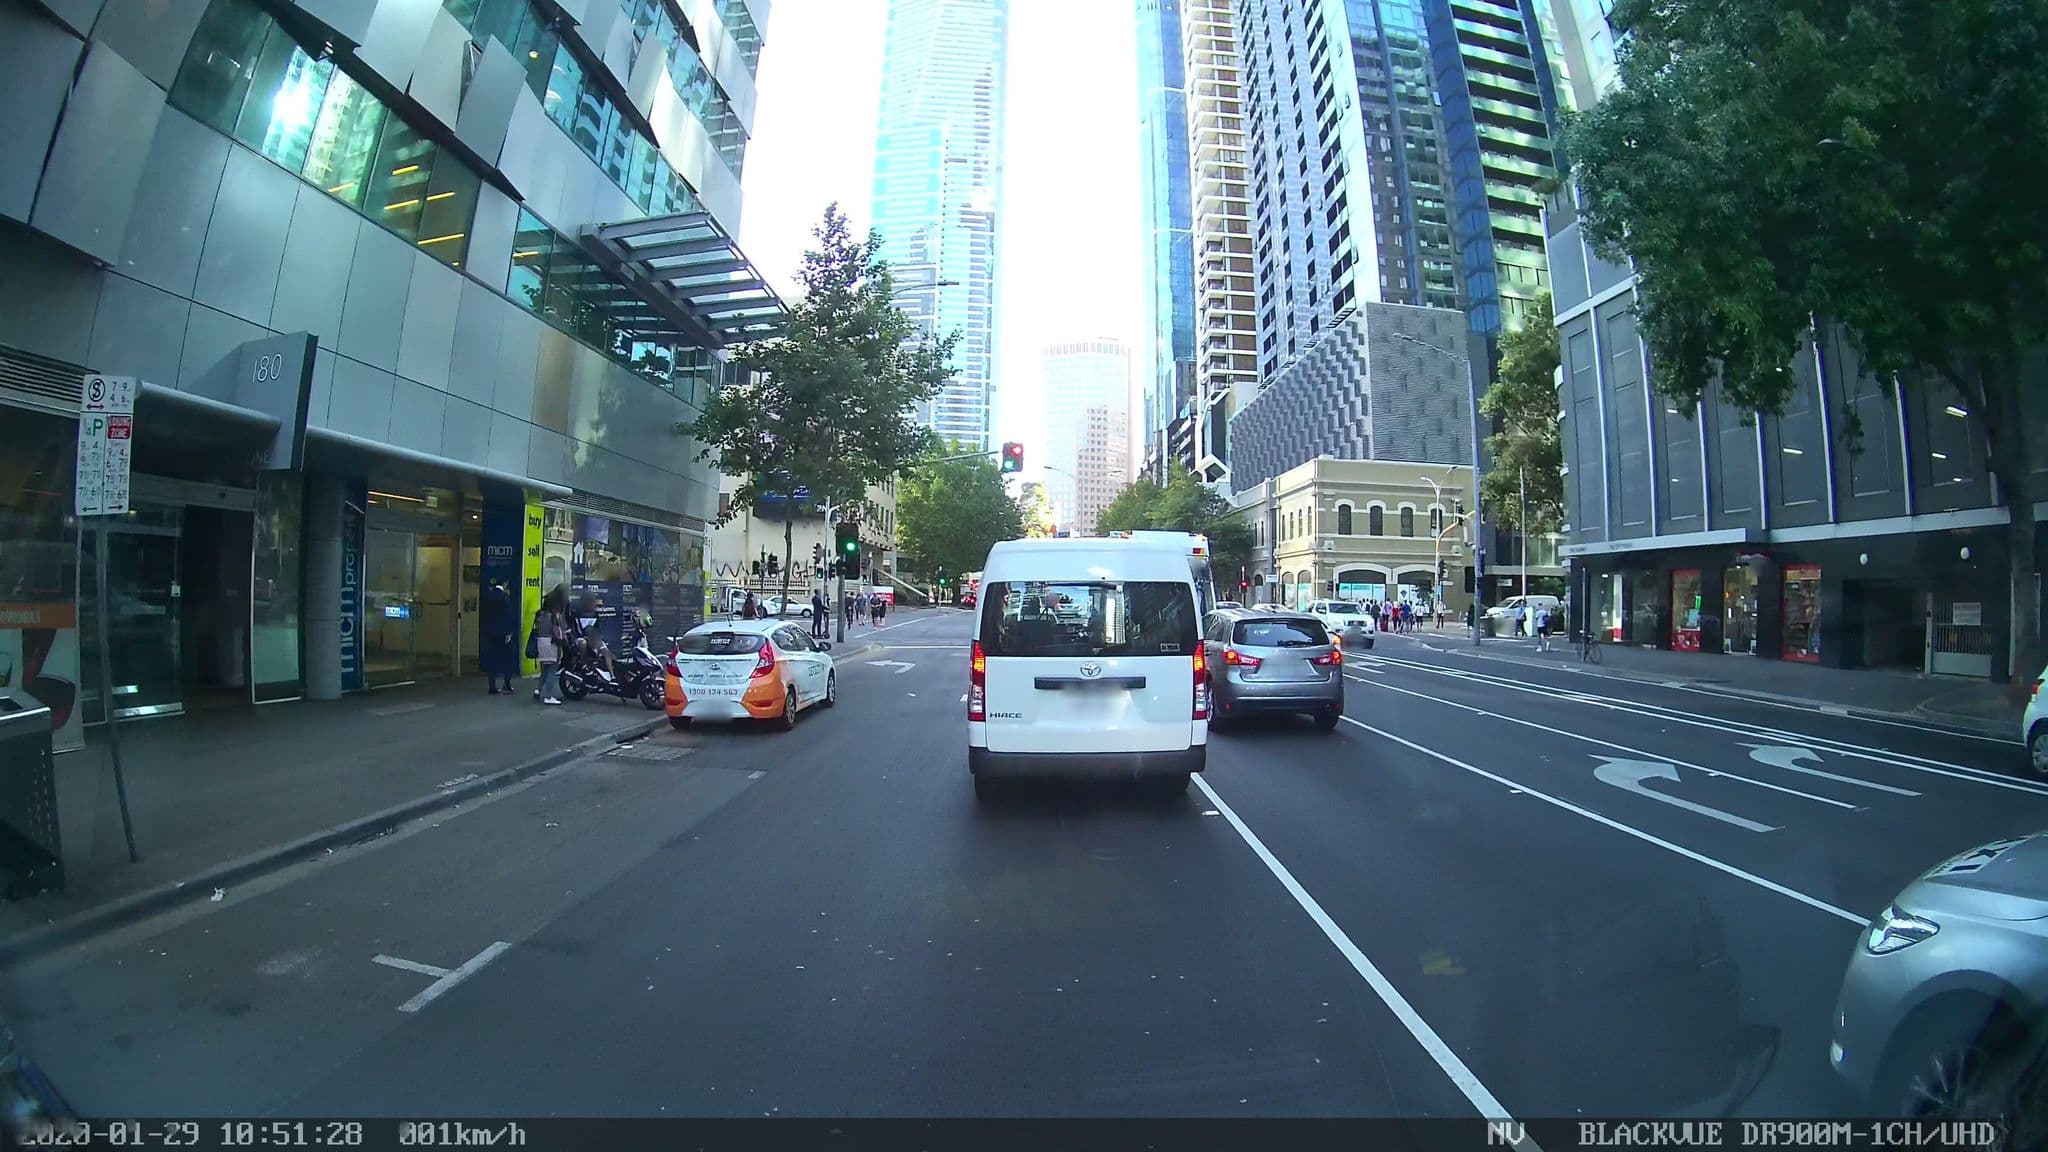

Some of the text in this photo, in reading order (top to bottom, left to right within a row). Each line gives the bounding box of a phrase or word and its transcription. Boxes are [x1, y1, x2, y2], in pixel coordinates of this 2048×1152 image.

[252, 353, 282, 384] 180
[528, 513, 541, 530] buy
[528, 544, 540, 557] sell
[526, 577, 540, 588] rent
